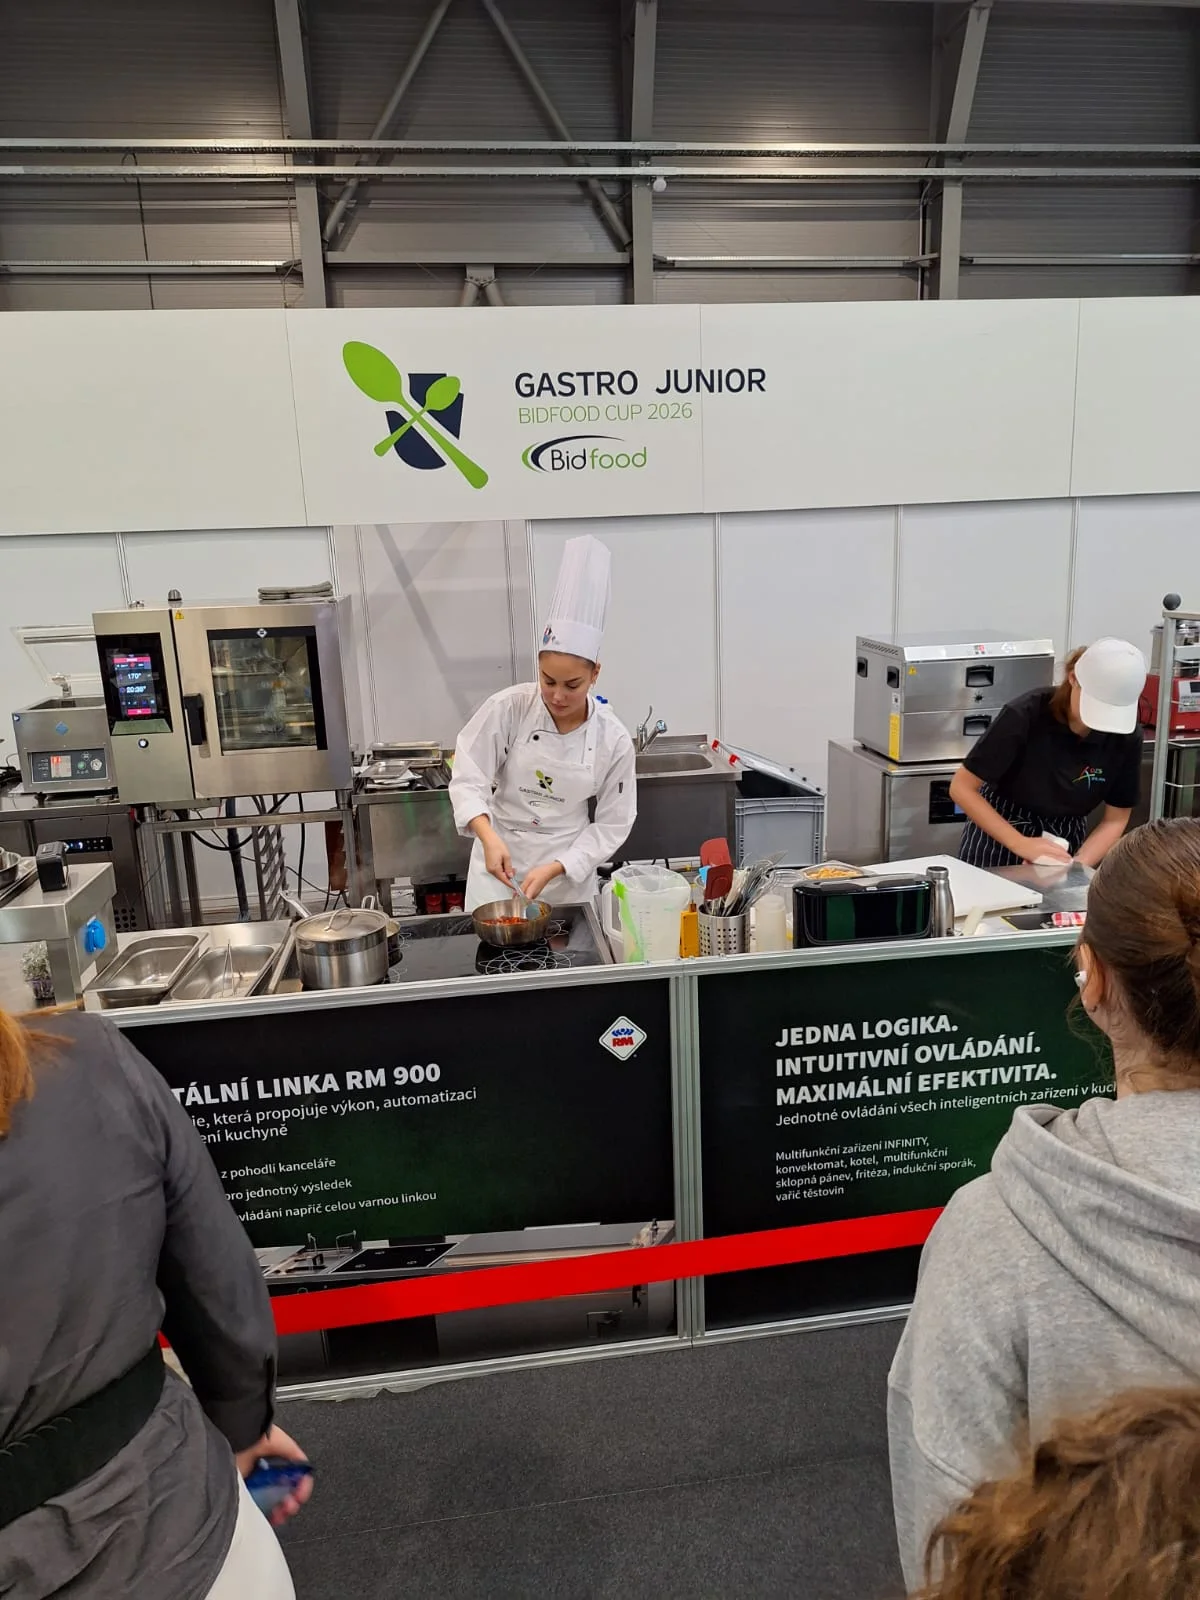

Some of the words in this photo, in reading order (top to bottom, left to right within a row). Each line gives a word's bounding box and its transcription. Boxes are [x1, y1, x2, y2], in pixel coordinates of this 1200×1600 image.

[514, 370, 638, 398] GASTRO
[655, 368, 766, 394] JUNIOR
[518, 405, 600, 424] BIDFOOD
[605, 404, 642, 421] CUP
[647, 402, 693, 420] 2026
[551, 447, 647, 471] Bidfood
[775, 1022, 856, 1047] JEDNA
[862, 1014, 958, 1040] LOGIKA.
[776, 1043, 909, 1077] INTUITIVNÍ
[914, 1031, 1041, 1064] OVLÁDÁNÍ.
[171, 1077, 249, 1106] TÁLNÍ
[256, 1073, 340, 1099] LINKA
[345, 1068, 387, 1090] RM
[393, 1063, 440, 1085] 900
[776, 1071, 912, 1106] MAXIMÁLNÍ
[918, 1063, 1057, 1092] EFEKTIVITA.
[192, 1115, 210, 1128] ie,
[213, 1110, 252, 1125] která
[256, 1103, 328, 1123] propojuje
[331, 1099, 380, 1116] výkon,
[383, 1087, 477, 1108] automatizaci
[776, 1108, 838, 1126] Jednotné
[841, 1103, 897, 1120] ovládání
[900, 1099, 936, 1114] všech
[940, 1090, 1028, 1110] inteligentních
[1030, 1083, 1078, 1100] zařízení
[1080, 1085, 1089, 1095] v
[1091, 1081, 1116, 1094] kuc
[225, 1124, 288, 1142] kuchyně
[776, 1145, 840, 1161] Multifunkční
[842, 1140, 882, 1154] zařízení
[884, 1136, 930, 1149] INFINITY,
[776, 1159, 848, 1175] konvektomat,
[850, 1154, 879, 1166] kotel,
[884, 1147, 948, 1163] multifunkční
[220, 1170, 228, 1179] z
[230, 1162, 276, 1180] pohodlí
[278, 1158, 336, 1173] kanceláře
[776, 1174, 817, 1189] sklopná
[820, 1173, 853, 1186] pánev,
[855, 1167, 891, 1179] fritéza,
[893, 1161, 937, 1175] indukční
[939, 1158, 976, 1172] sporák,
[245, 1184, 298, 1201] jednotný
[301, 1178, 353, 1194] výsledek
[776, 1189, 800, 1201] vařič
[803, 1186, 844, 1198] těstovin
[238, 1208, 282, 1222] vládání
[285, 1203, 322, 1217] napříč
[324, 1200, 356, 1212] celou
[359, 1196, 399, 1208] varnou
[401, 1191, 437, 1203] linkou
